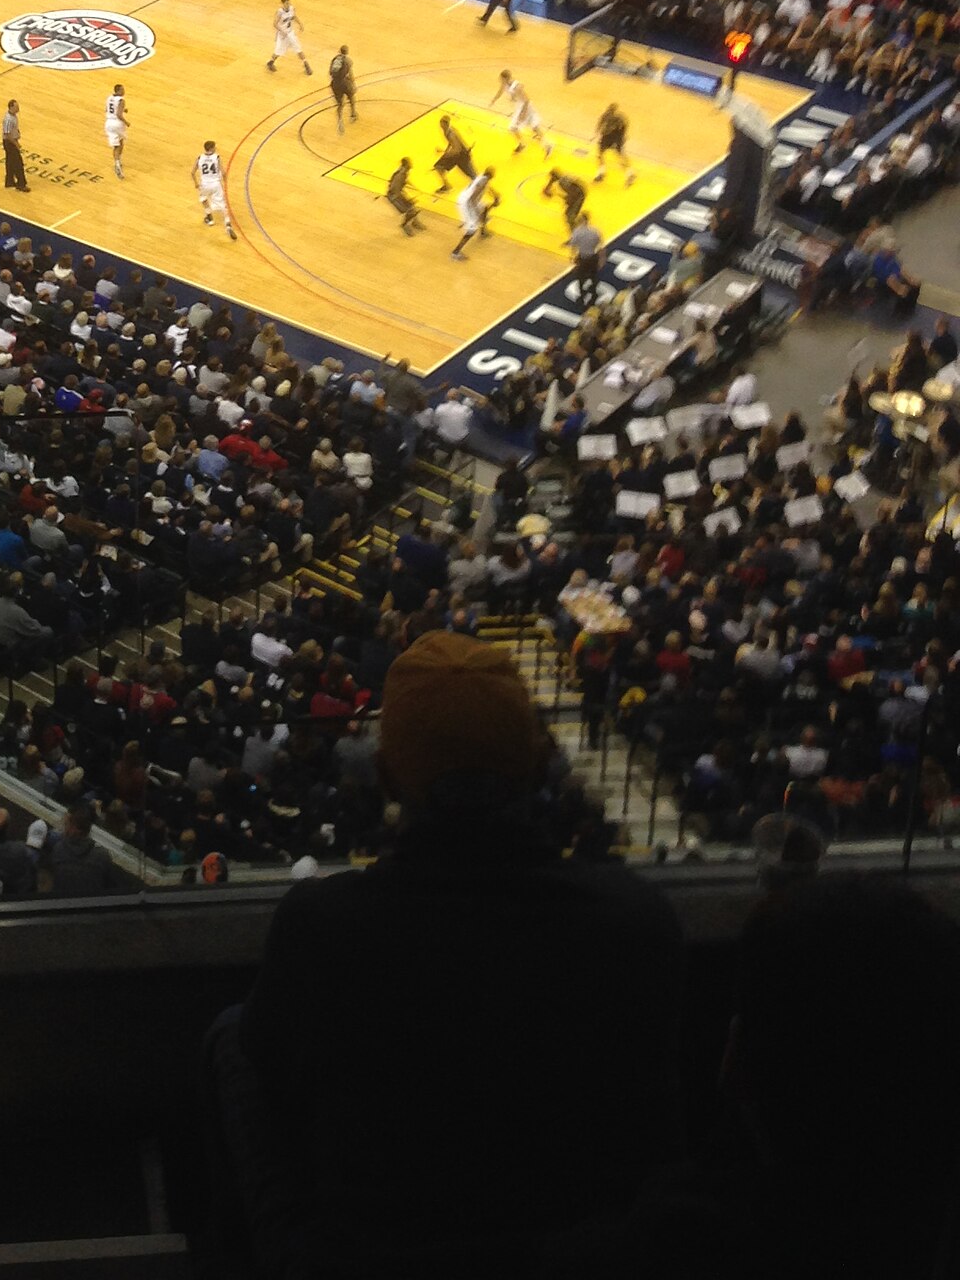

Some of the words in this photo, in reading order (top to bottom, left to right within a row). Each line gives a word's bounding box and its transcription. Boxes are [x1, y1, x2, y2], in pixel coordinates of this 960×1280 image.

[5, 15, 150, 65] CROSSROADS
[59, 163, 105, 183] LIFE
[201, 162, 218, 175] 24
